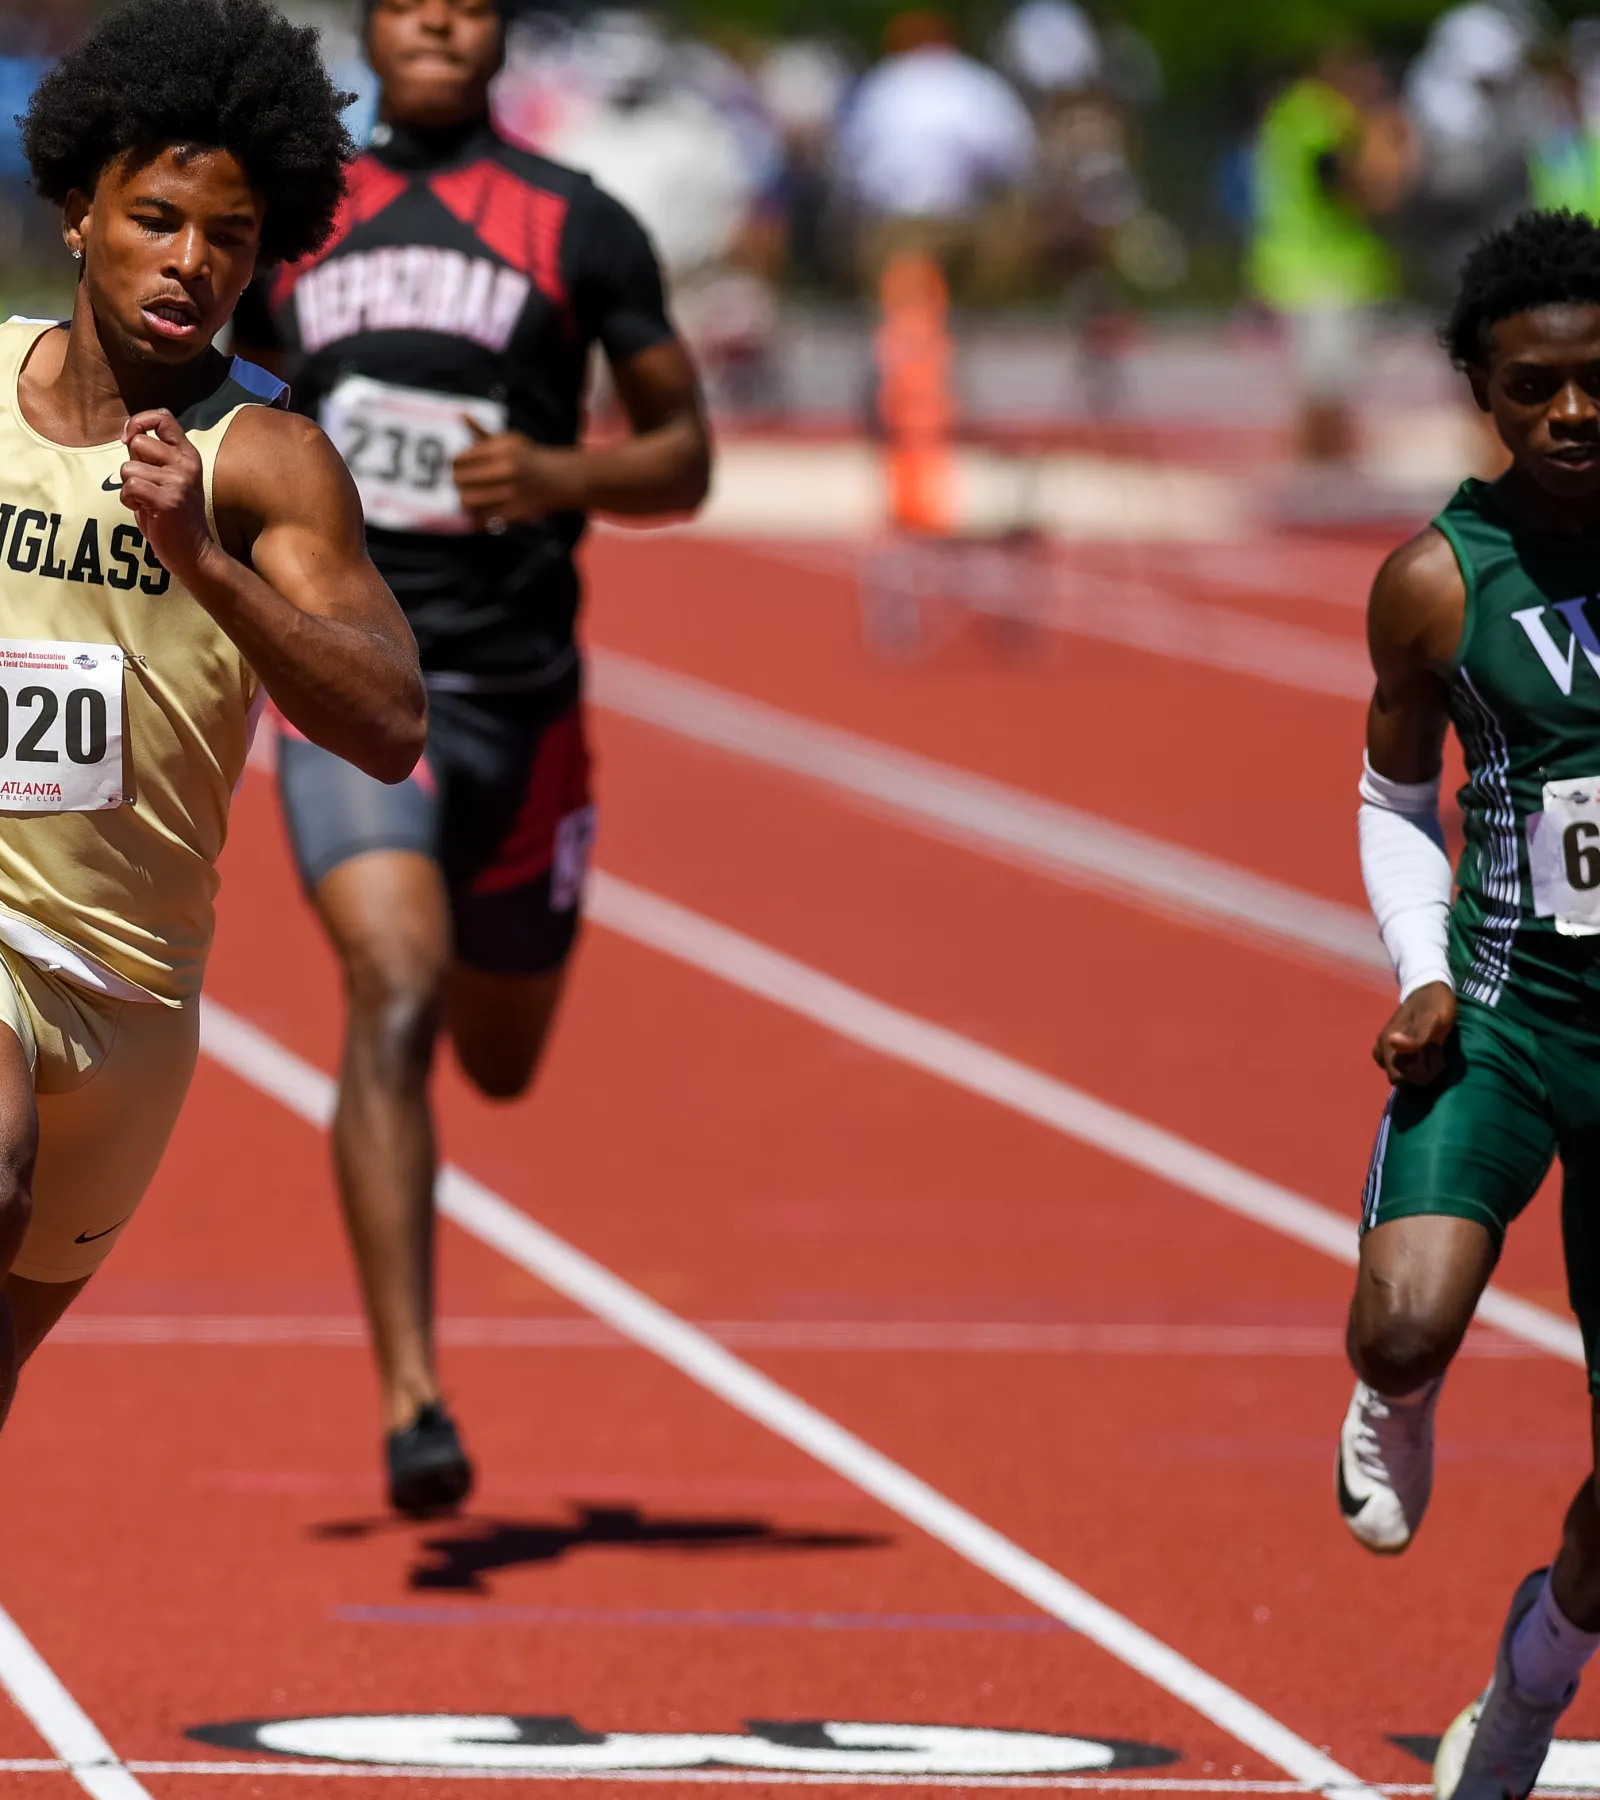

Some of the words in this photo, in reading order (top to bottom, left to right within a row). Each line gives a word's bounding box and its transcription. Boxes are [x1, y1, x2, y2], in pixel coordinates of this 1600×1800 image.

[6, 651, 27, 659] School
[28, 652, 66, 661] Association
[3, 660, 18, 668] Field
[19, 661, 69, 671] Championships
[0, 781, 62, 796] ATLANTA
[0, 794, 31, 802] TRACK
